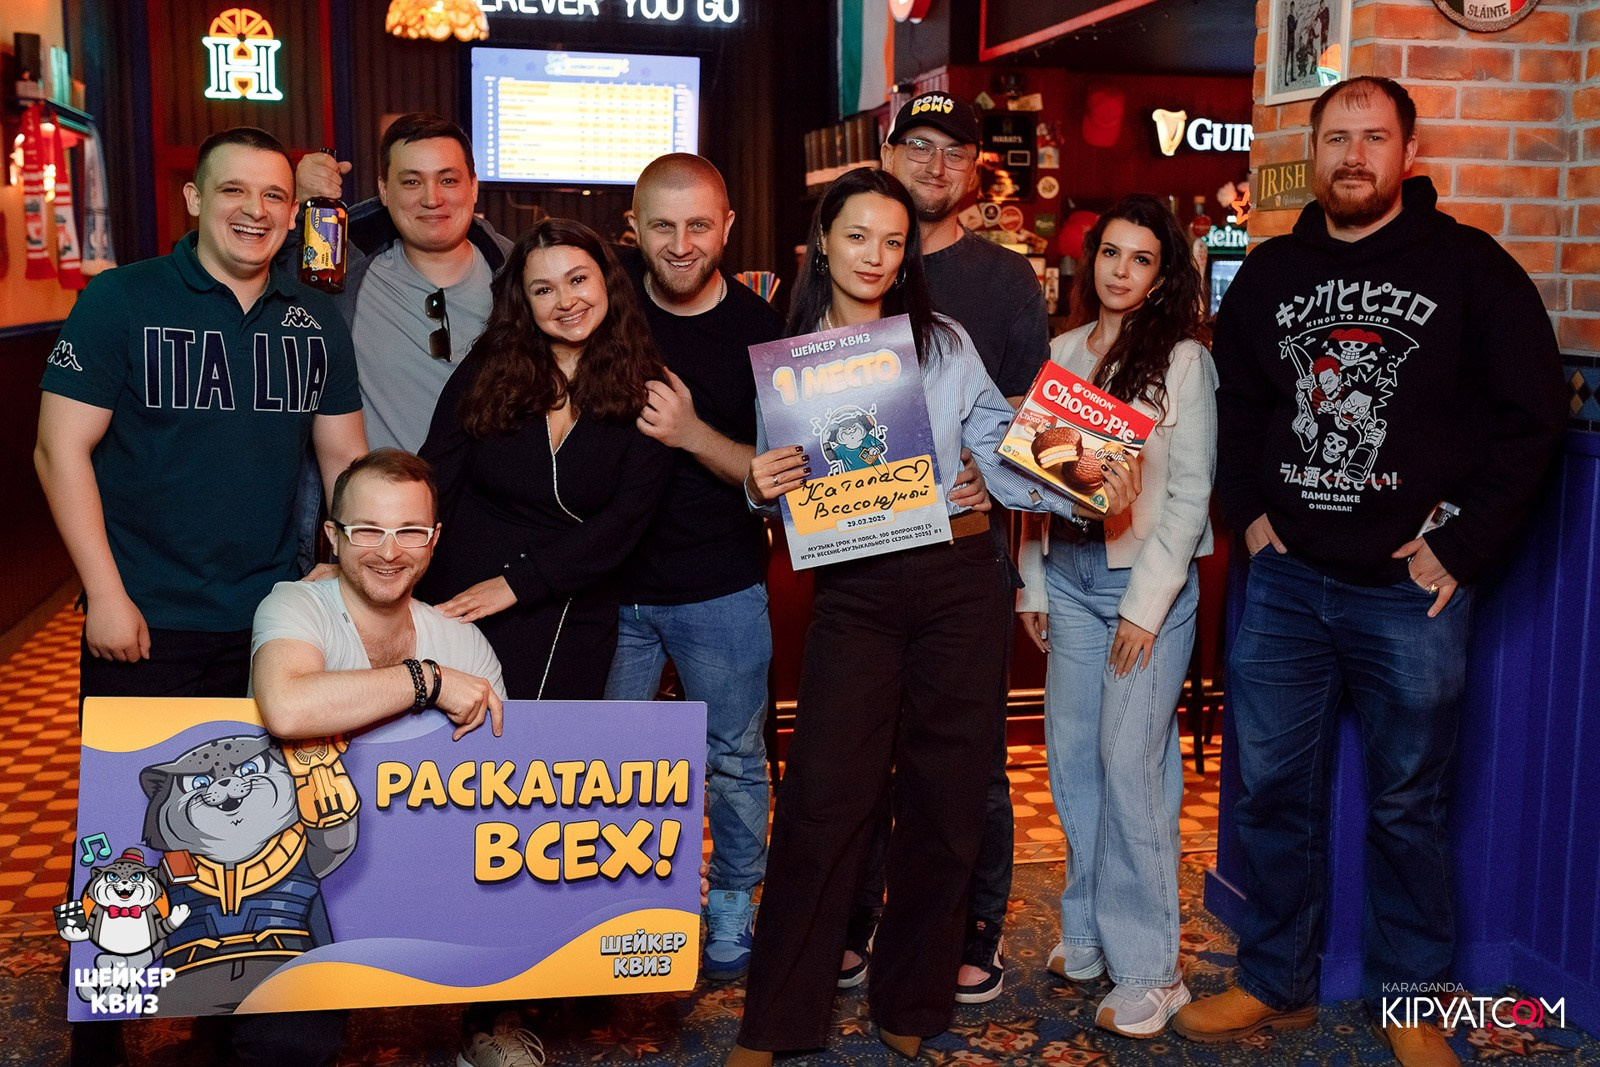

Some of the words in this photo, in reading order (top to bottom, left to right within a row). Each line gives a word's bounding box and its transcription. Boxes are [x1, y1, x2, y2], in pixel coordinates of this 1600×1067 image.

[697, 0, 739, 23] GO
[1467, 3, 1509, 19] SLÁINTE
[1260, 163, 1306, 201] IRISH
[1275, 279, 1438, 329] キングとピエロ
[1358, 314, 1390, 324] PIERO
[791, 340, 836, 358] ШЕЙКЕР
[840, 333, 871, 348] КВИЗ
[773, 366, 798, 405] 1
[802, 349, 901, 401] МЕСТО
[1301, 490, 1331, 501] RAMU
[1332, 494, 1361, 503] SAKE
[847, 514, 886, 528] 29.03.2025
[807, 543, 835, 552] МУЗЫКА
[891, 534, 914, 543] СЕЗОНА
[376, 760, 690, 809] РАСКАТАЛИ
[474, 819, 682, 884] ВСЕХ!
[600, 929, 687, 955] ШЕЙКЕР
[613, 956, 672, 977] КВИЗ
